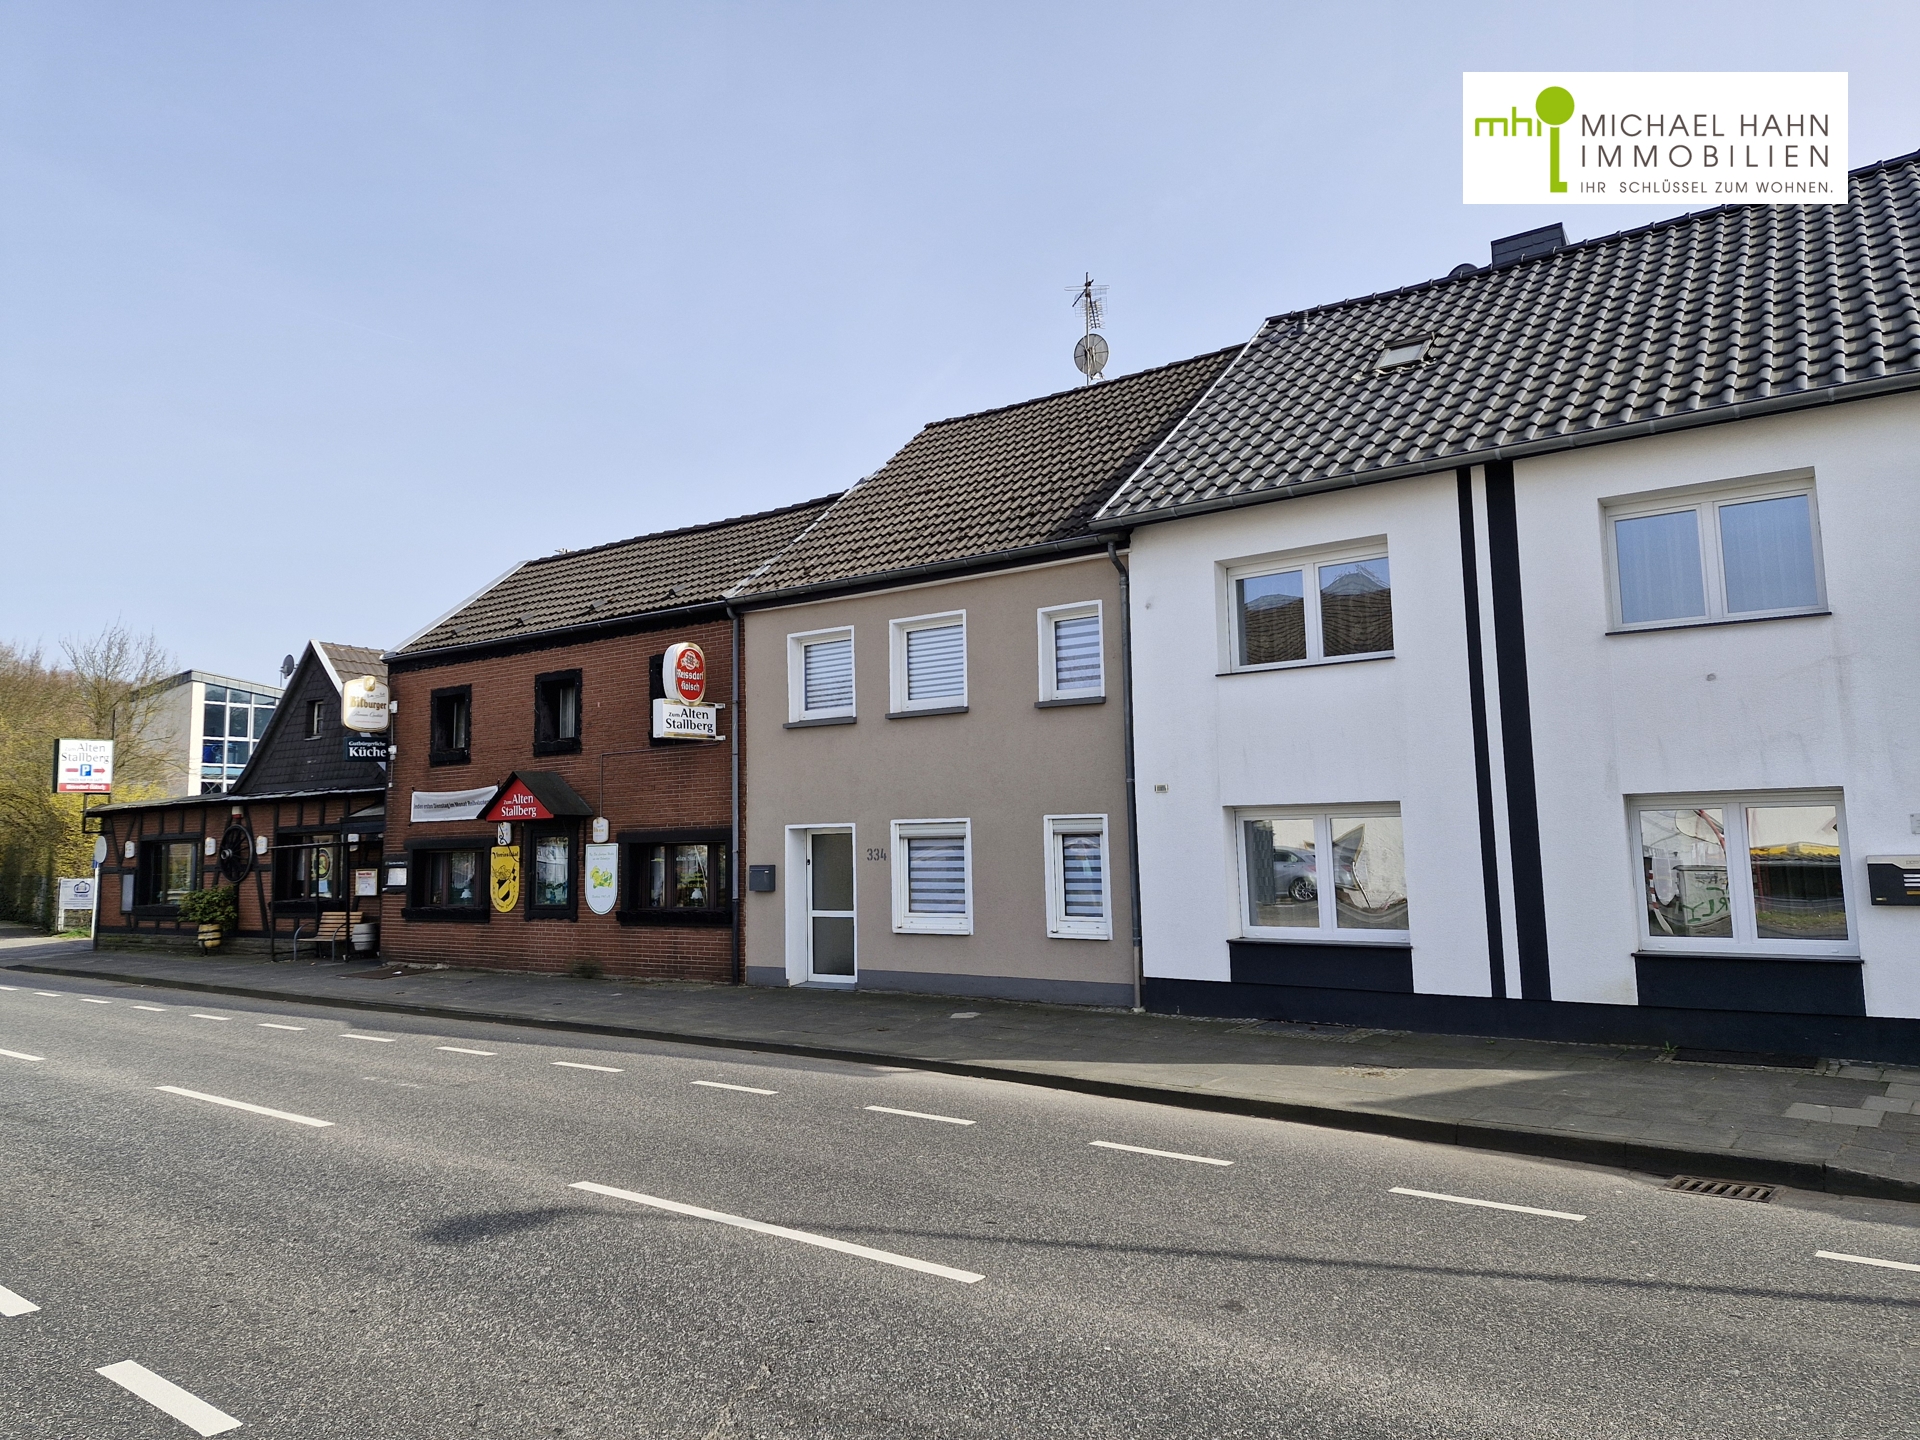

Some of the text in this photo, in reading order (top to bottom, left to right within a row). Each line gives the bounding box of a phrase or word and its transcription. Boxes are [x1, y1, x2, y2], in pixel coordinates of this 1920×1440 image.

[680, 708, 709, 720] Alten
[665, 718, 714, 734] Stallberg
[77, 742, 106, 753] Alten
[348, 746, 387, 758] Küche
[61, 752, 110, 765] Stallberg
[512, 794, 534, 805] Alten
[501, 805, 537, 818] Stallberg
[866, 848, 887, 861] 334
